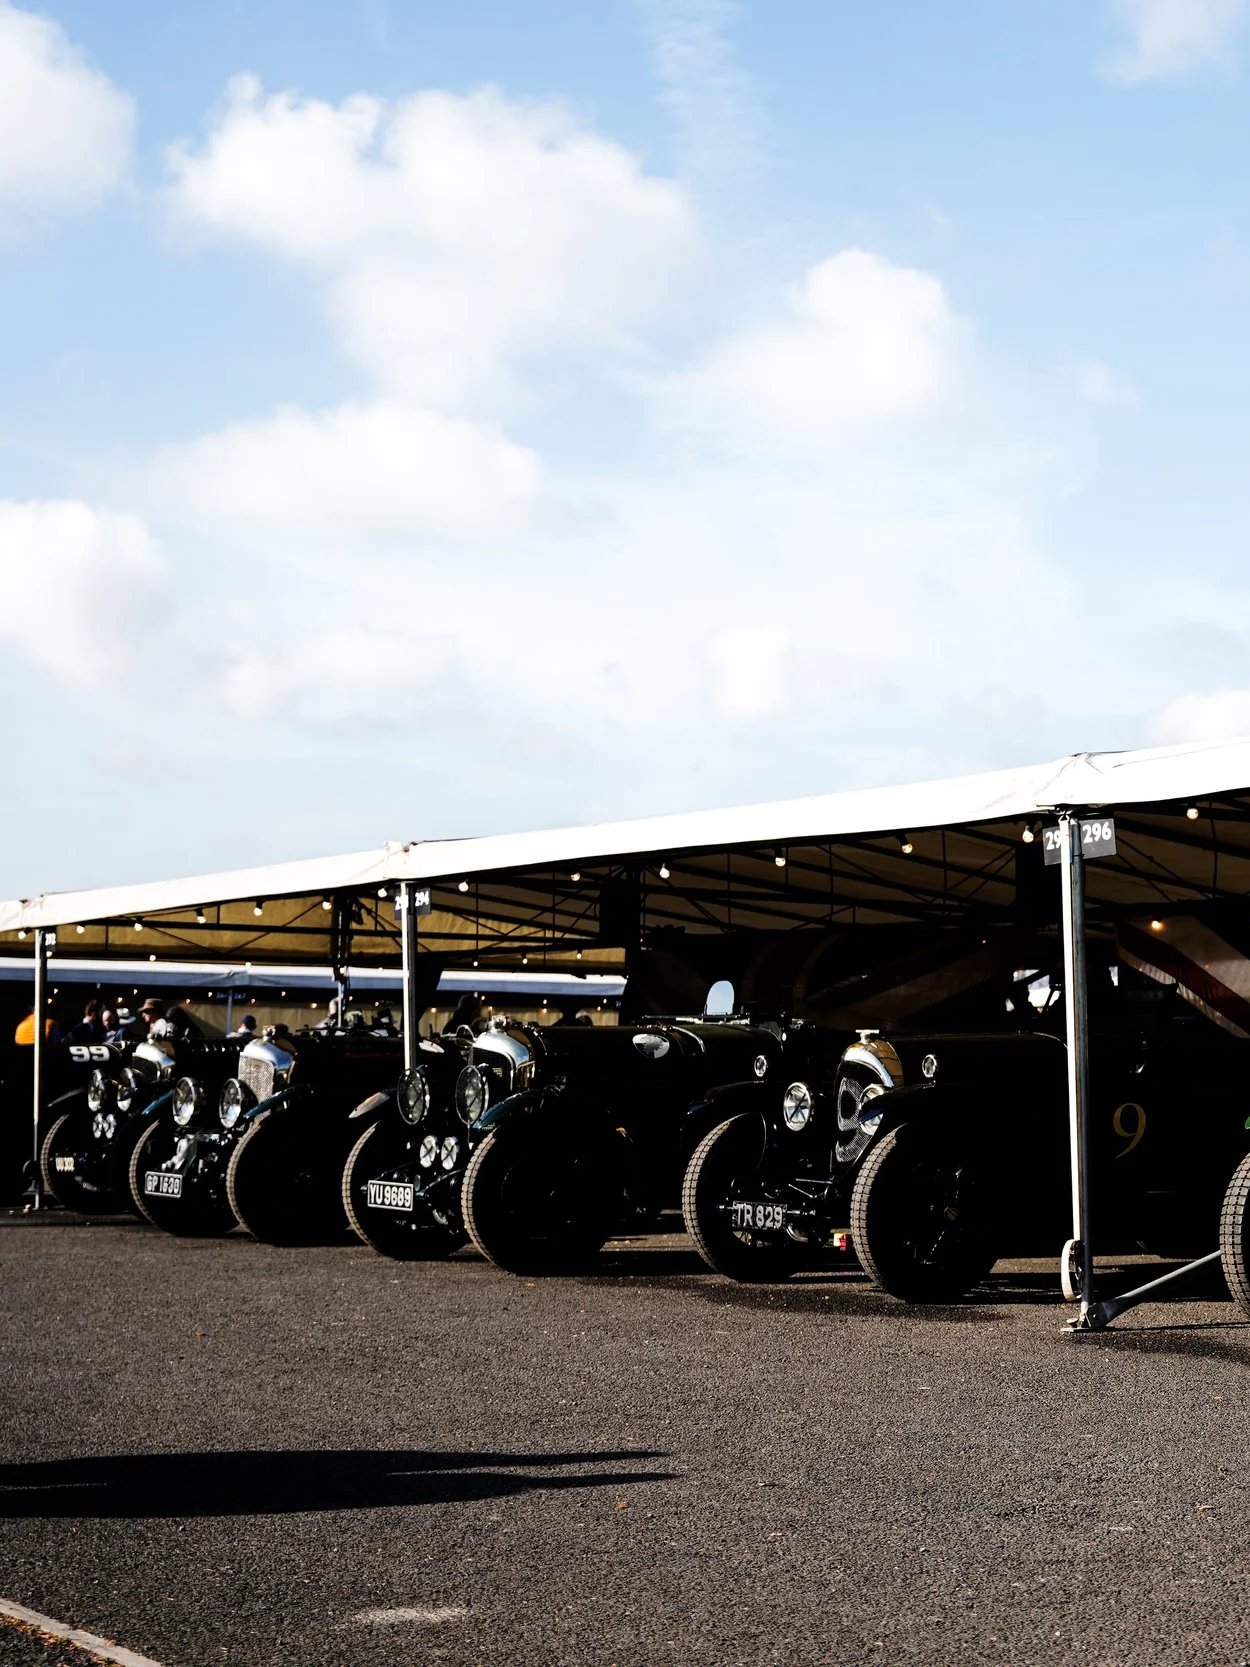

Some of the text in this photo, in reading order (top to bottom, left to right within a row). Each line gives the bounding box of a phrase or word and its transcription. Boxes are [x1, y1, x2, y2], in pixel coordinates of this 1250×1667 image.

[1045, 828, 1061, 851] 29
[1082, 821, 1112, 843] 296
[414, 890, 430, 907] 294
[69, 1045, 110, 1063] 99
[1113, 1102, 1146, 1160] 9
[735, 1203, 783, 1229] TR 829
